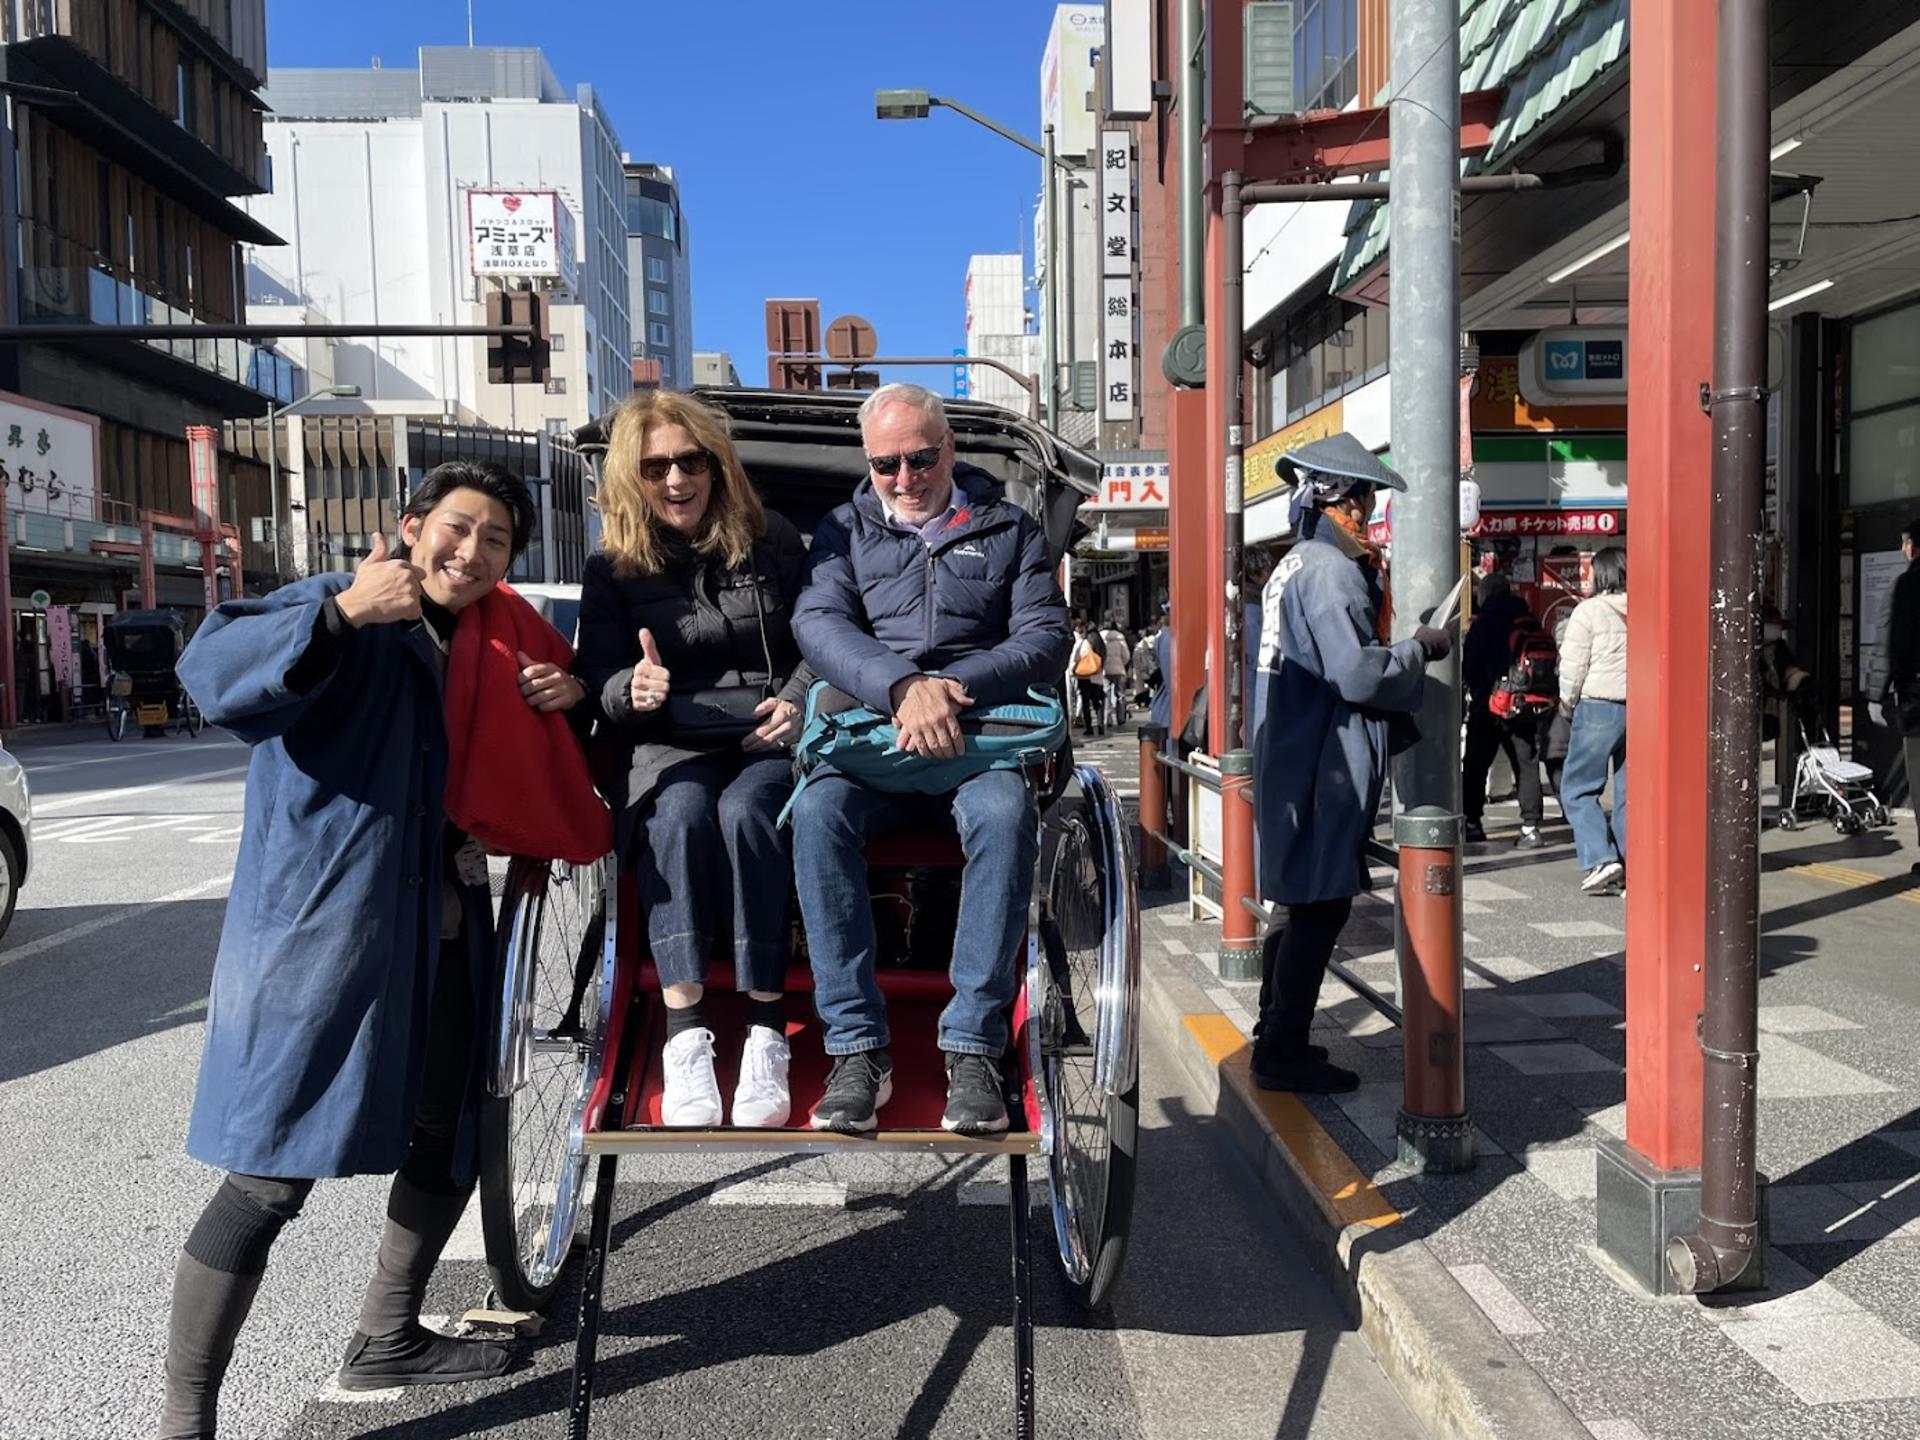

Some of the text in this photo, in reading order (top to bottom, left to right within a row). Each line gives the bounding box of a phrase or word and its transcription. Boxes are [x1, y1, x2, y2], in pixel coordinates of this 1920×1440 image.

[475, 226, 553, 243] アミューズ
[491, 245, 535, 257] 浅草店
[1106, 149, 1128, 402] 紀文堂総本店
[1088, 480, 1163, 503] 門入
